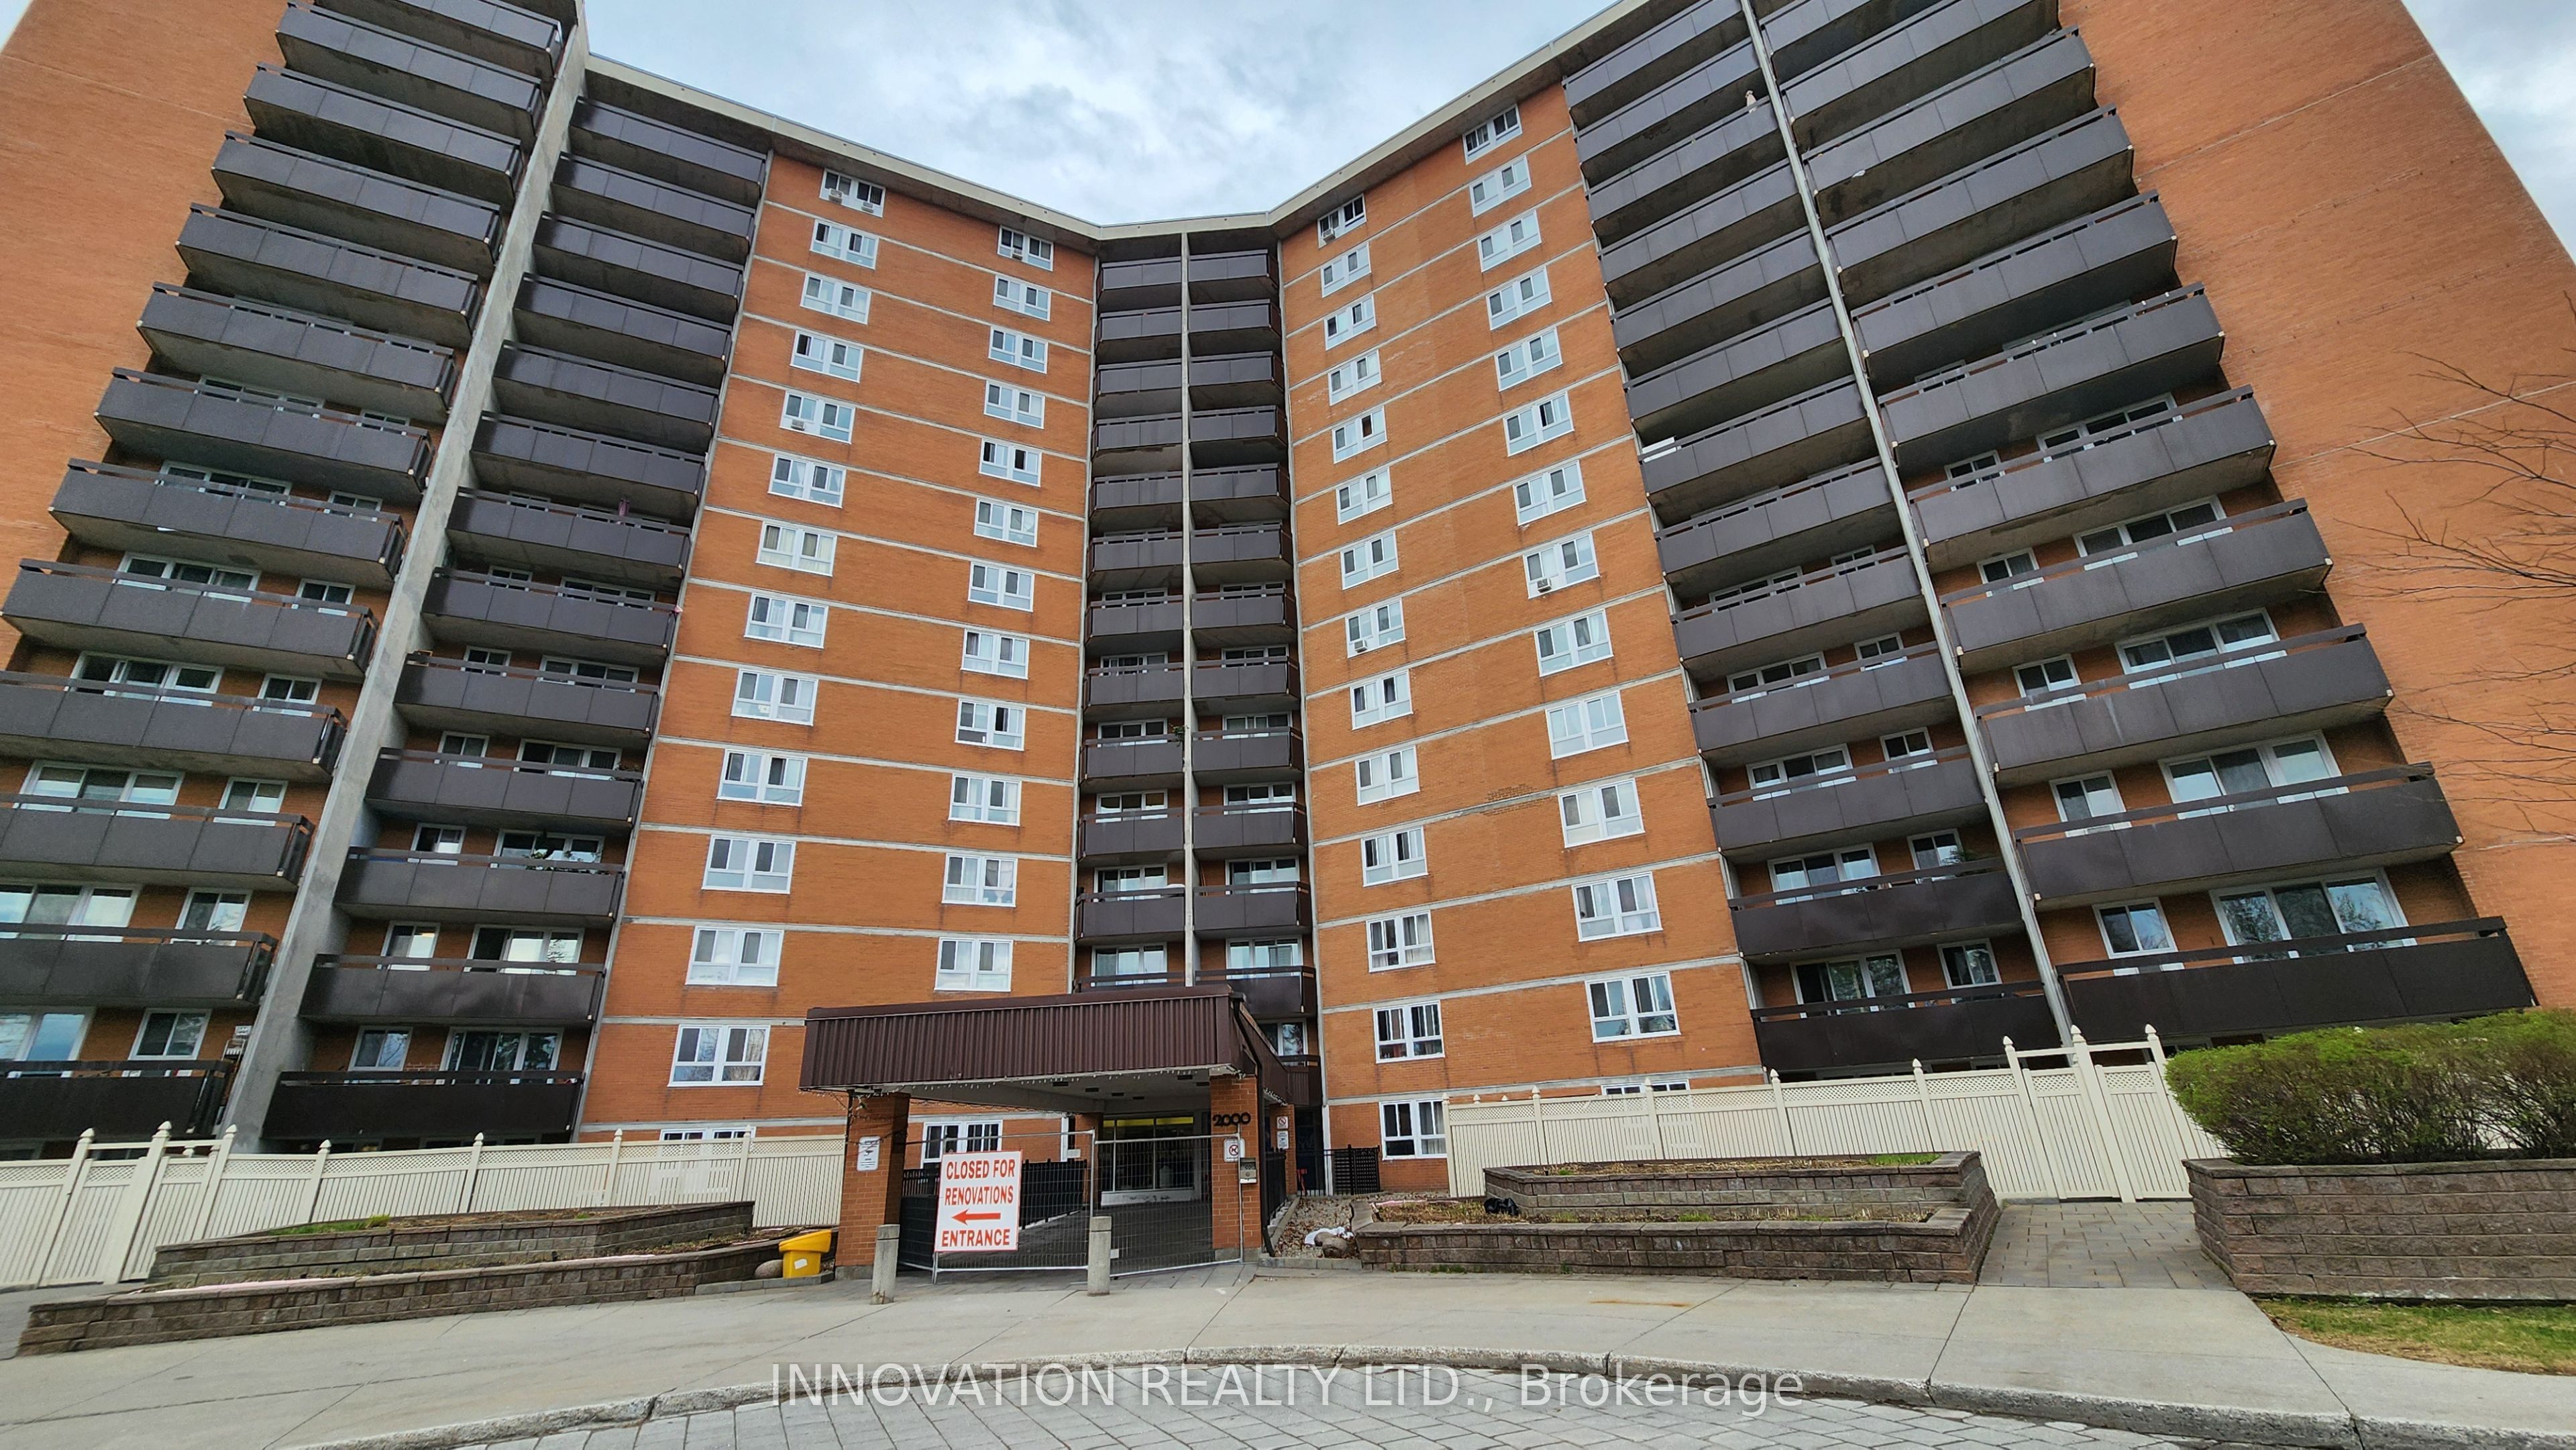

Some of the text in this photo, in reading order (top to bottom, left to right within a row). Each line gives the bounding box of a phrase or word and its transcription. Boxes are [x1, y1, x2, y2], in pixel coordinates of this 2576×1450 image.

[1212, 1112, 1251, 1127] 2000
[947, 1159, 1016, 1180] CLOSED FOR
[945, 1185, 1014, 1206] RENOVATIONS
[941, 1229, 1010, 1247] ENTRANCE
